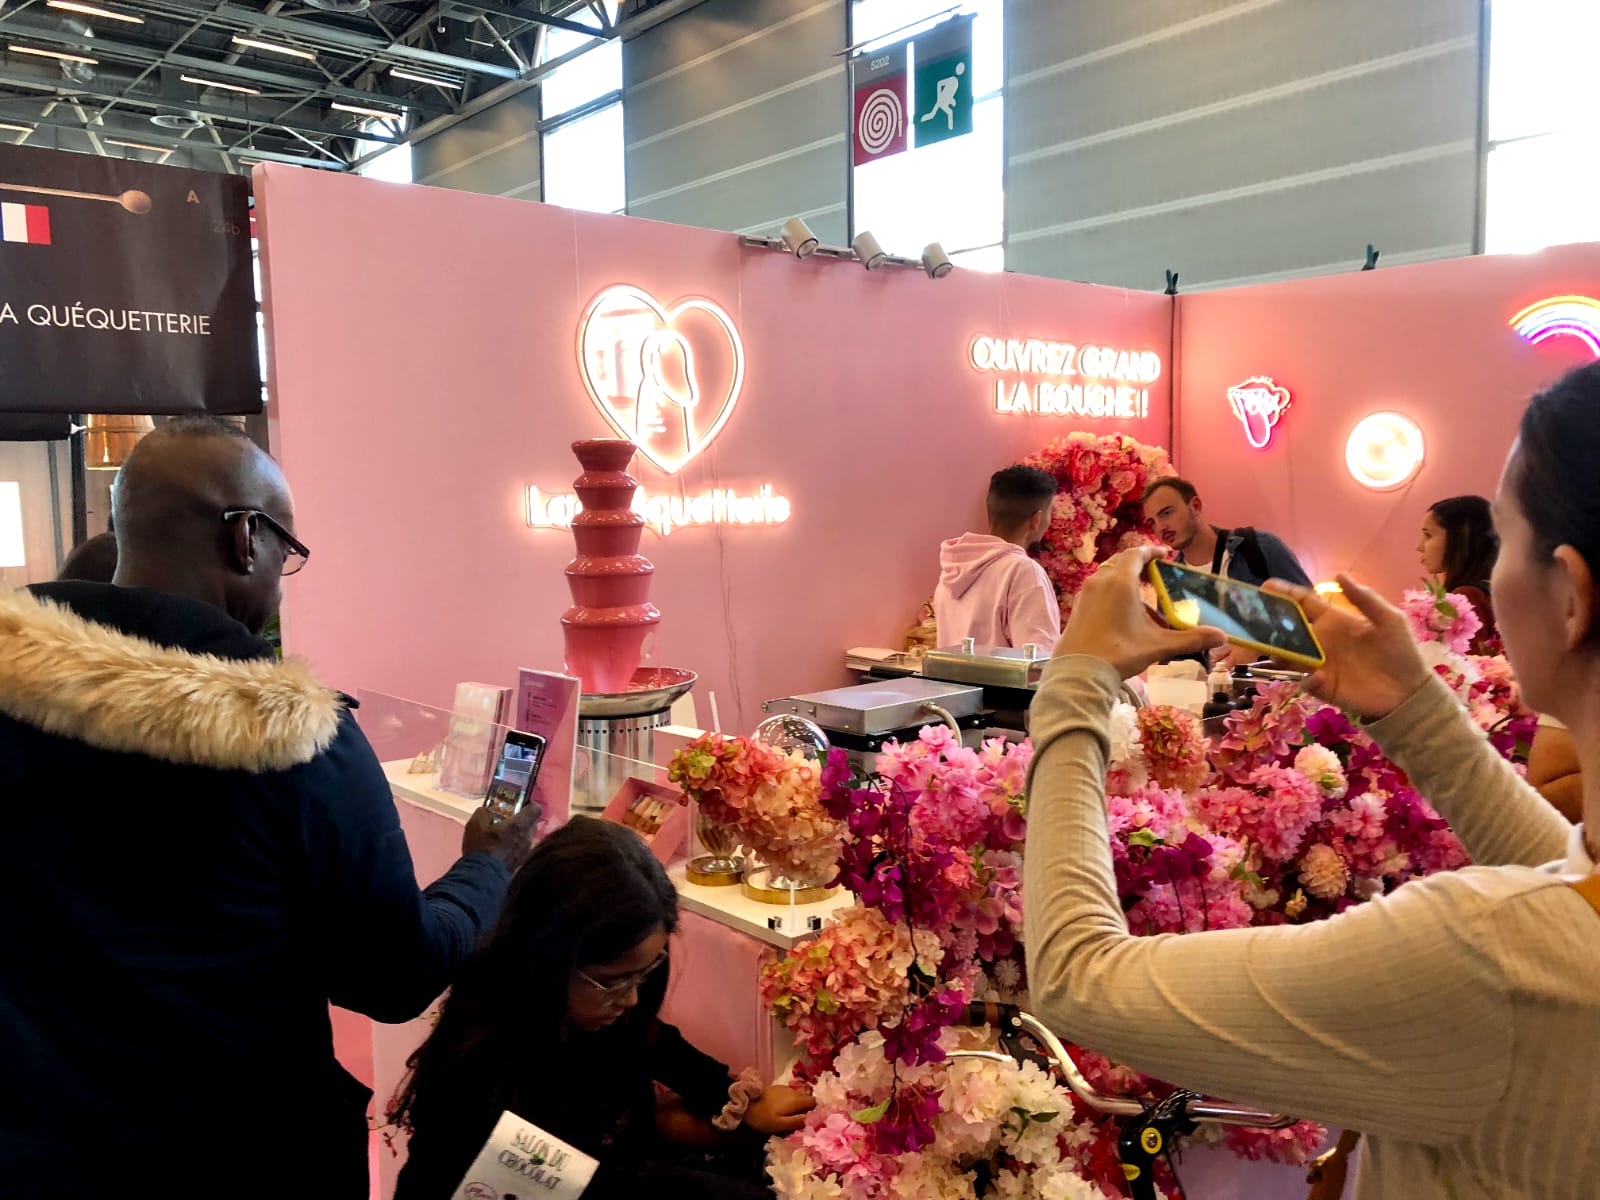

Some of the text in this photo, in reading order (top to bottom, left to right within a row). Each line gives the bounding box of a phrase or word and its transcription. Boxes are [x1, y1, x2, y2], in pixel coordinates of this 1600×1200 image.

[186, 190, 200, 204] A
[27, 301, 212, 335] QUÉQUETTERIE
[970, 335, 1161, 382] OUVREZ GRAND
[995, 379, 1032, 412] LA
[498, 1150, 562, 1190] CHOCOLAT
